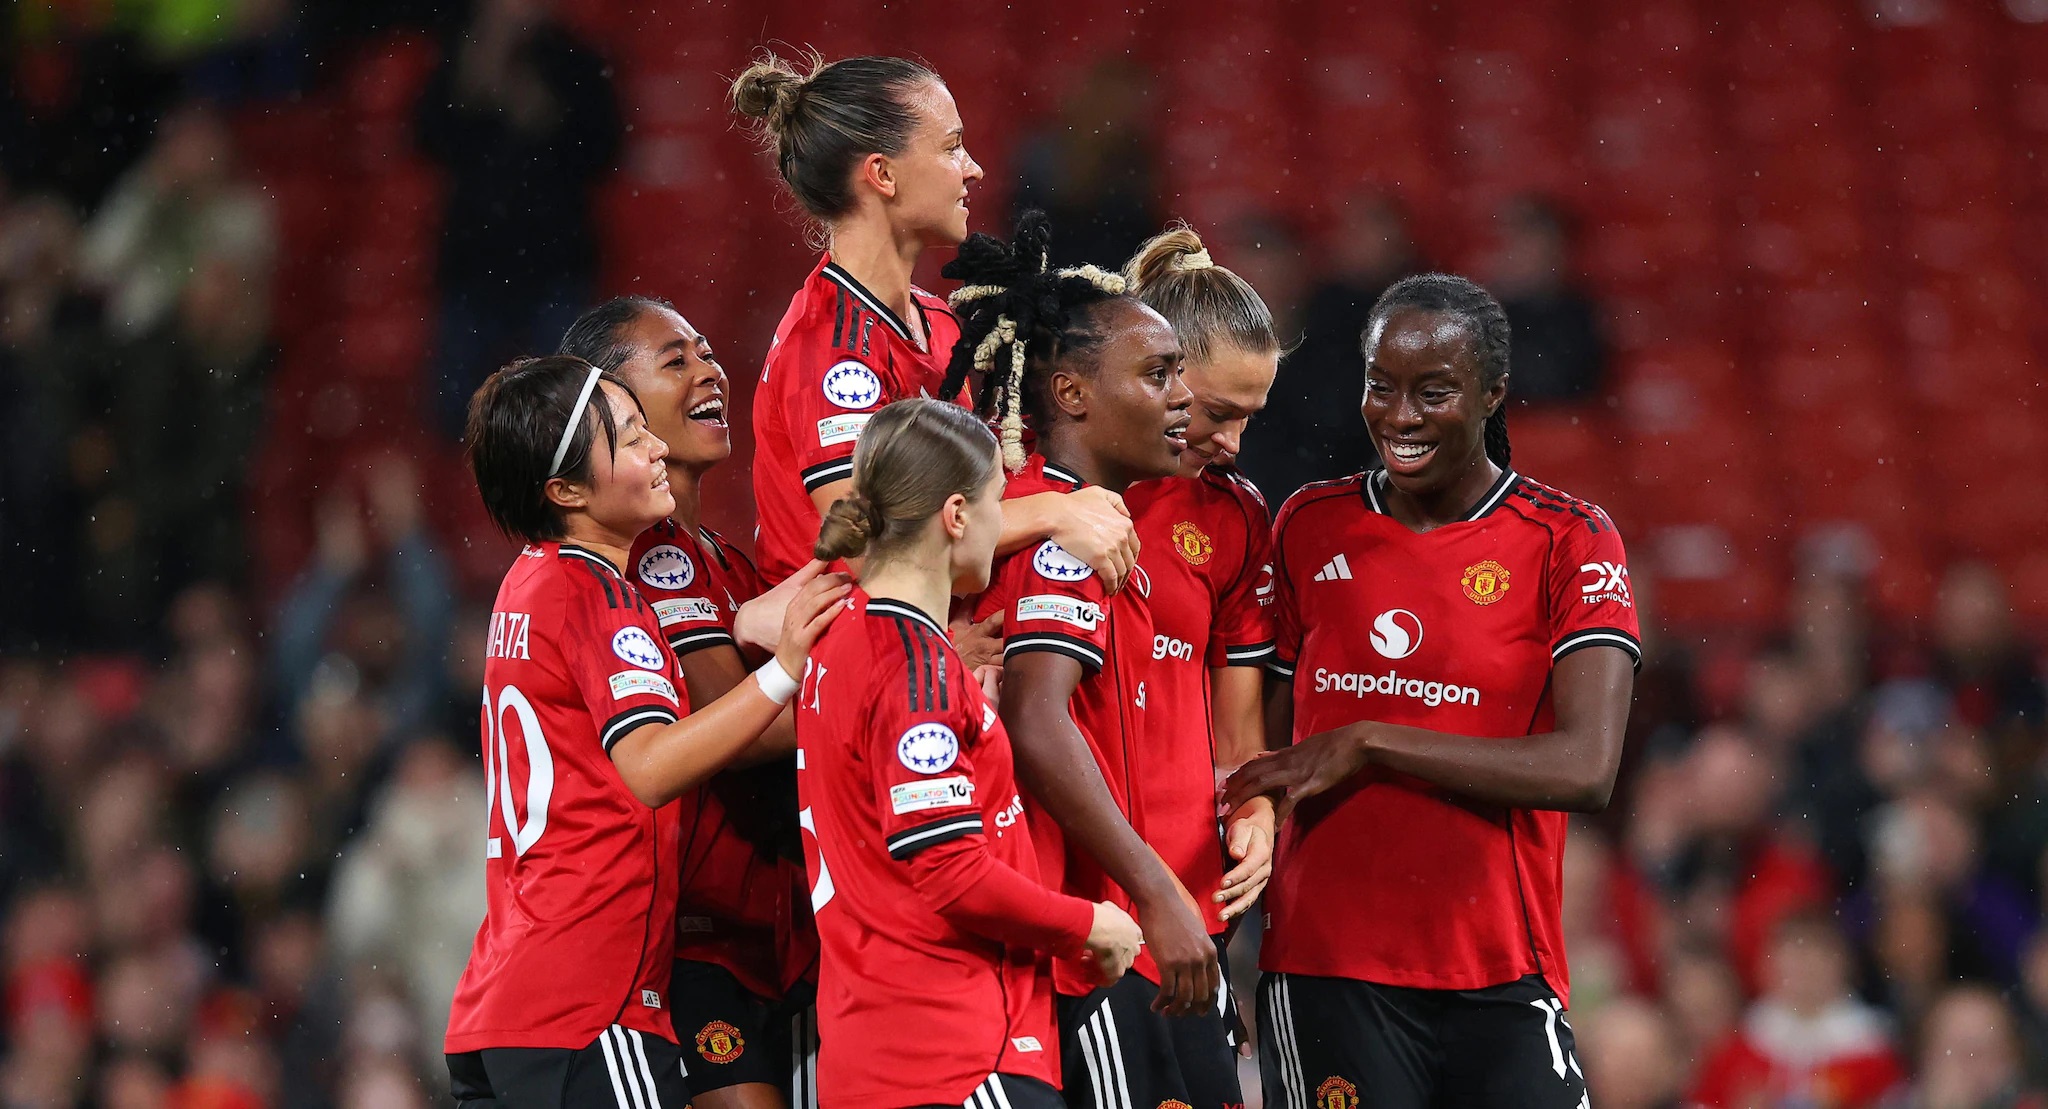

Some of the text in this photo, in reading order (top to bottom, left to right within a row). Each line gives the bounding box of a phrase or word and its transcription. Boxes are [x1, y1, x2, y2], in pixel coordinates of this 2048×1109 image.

[821, 423, 866, 436] FOUNDATI
[1468, 563, 1507, 579] MANCHESTER
[1470, 592, 1497, 601] UNITED
[1019, 603, 1075, 616] FOUNDATION
[1315, 667, 1480, 706] Snapdragon
[700, 1023, 738, 1041] MANCHESTER
[712, 1051, 739, 1061] UNITED
